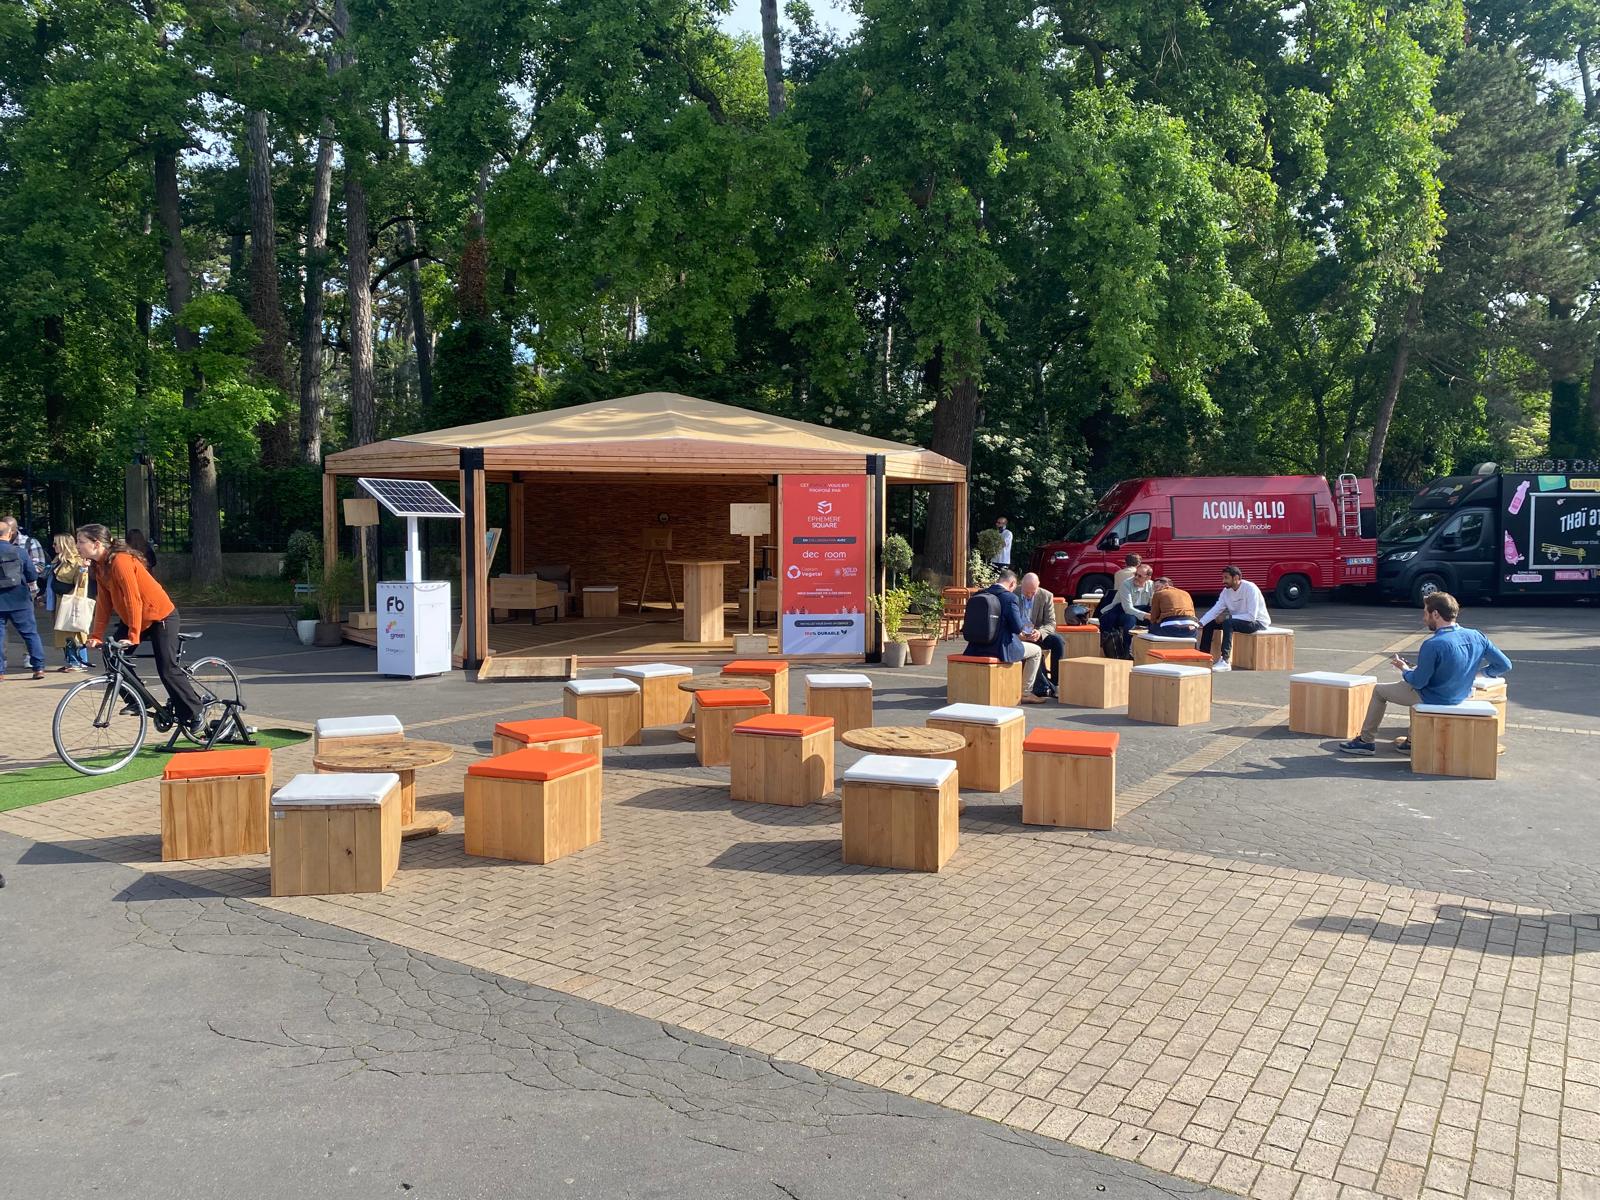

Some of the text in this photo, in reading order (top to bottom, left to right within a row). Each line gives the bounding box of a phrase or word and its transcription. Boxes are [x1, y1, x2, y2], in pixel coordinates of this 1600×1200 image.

[1516, 459, 1567, 472] FOOD
[1202, 501, 1245, 519] ACQUA
[1255, 501, 1285, 519] OLIO
[802, 550, 847, 559] dec room
[386, 596, 404, 611] Fb
